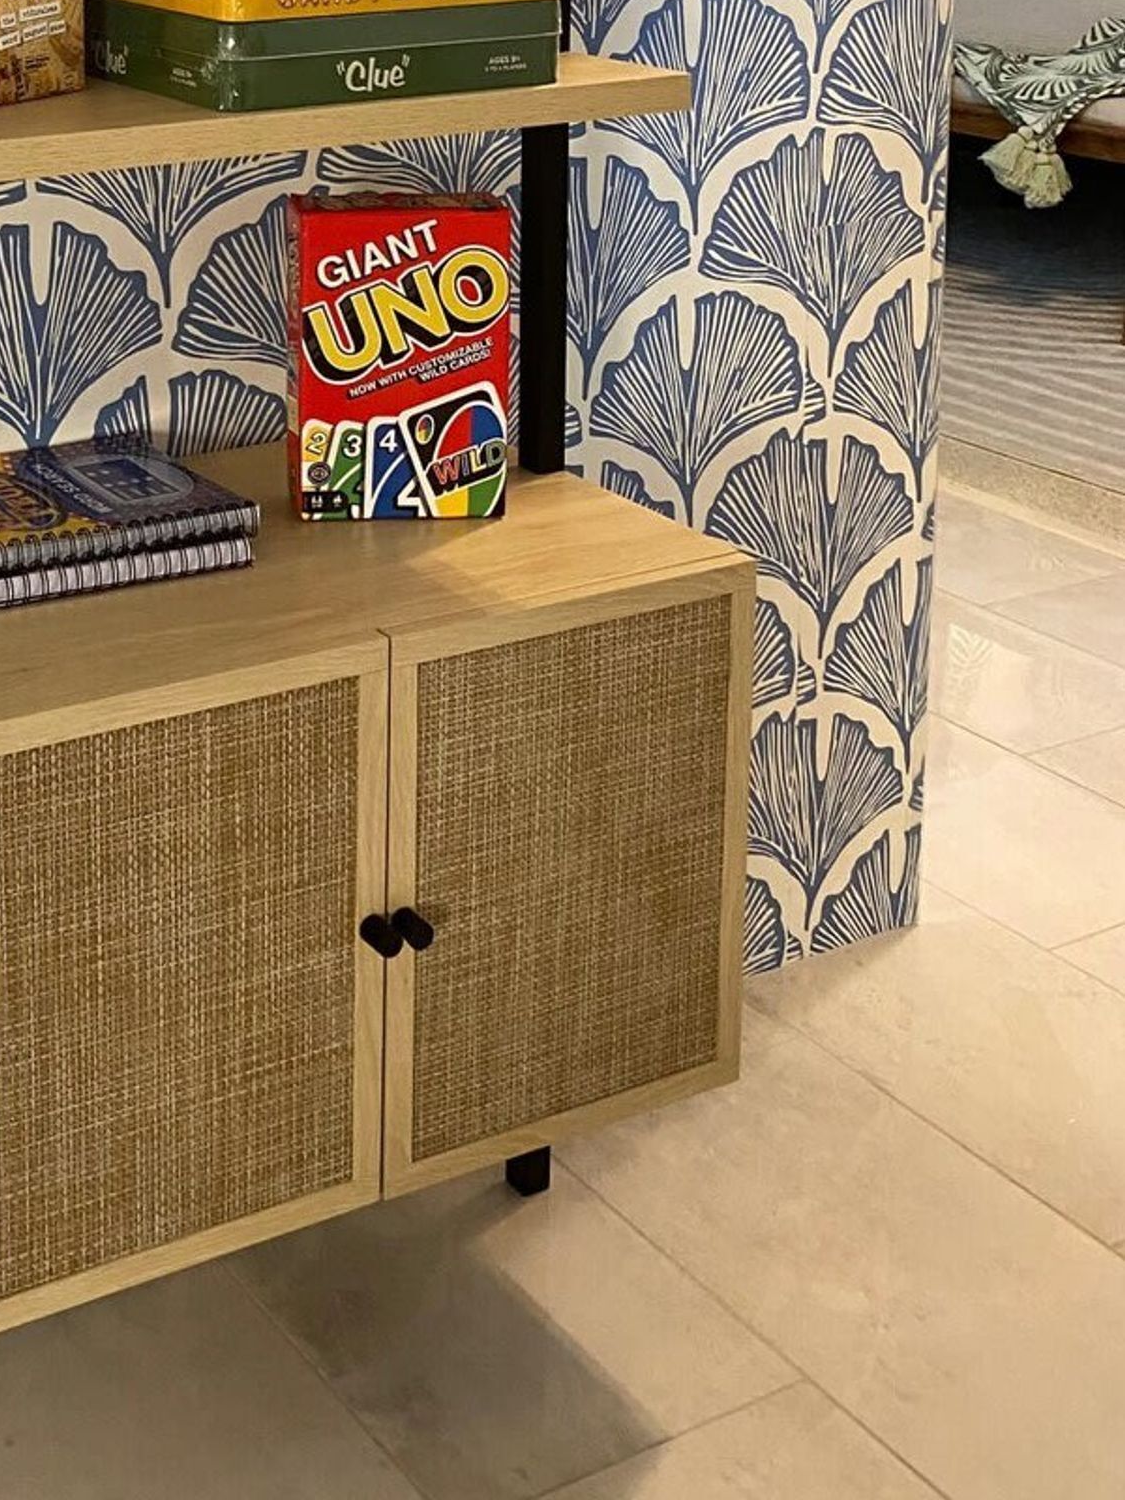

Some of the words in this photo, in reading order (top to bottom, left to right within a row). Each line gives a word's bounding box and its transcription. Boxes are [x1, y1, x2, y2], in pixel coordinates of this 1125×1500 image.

[336, 53, 410, 92] "Clue"
[489, 56, 510, 64] AGES
[316, 218, 438, 289] GIANT
[305, 247, 509, 376] UNO
[349, 380, 376, 398] NOW
[378, 371, 407, 387] WITH
[408, 337, 494, 376] CUSTOMIZABLE
[418, 365, 449, 382] WILD
[450, 349, 492, 371] CARDS!
[307, 431, 328, 454] 2
[343, 435, 361, 458] 3
[379, 430, 398, 451] 4
[430, 440, 507, 486] WILD
[32, 463, 80, 494] SEARCH
